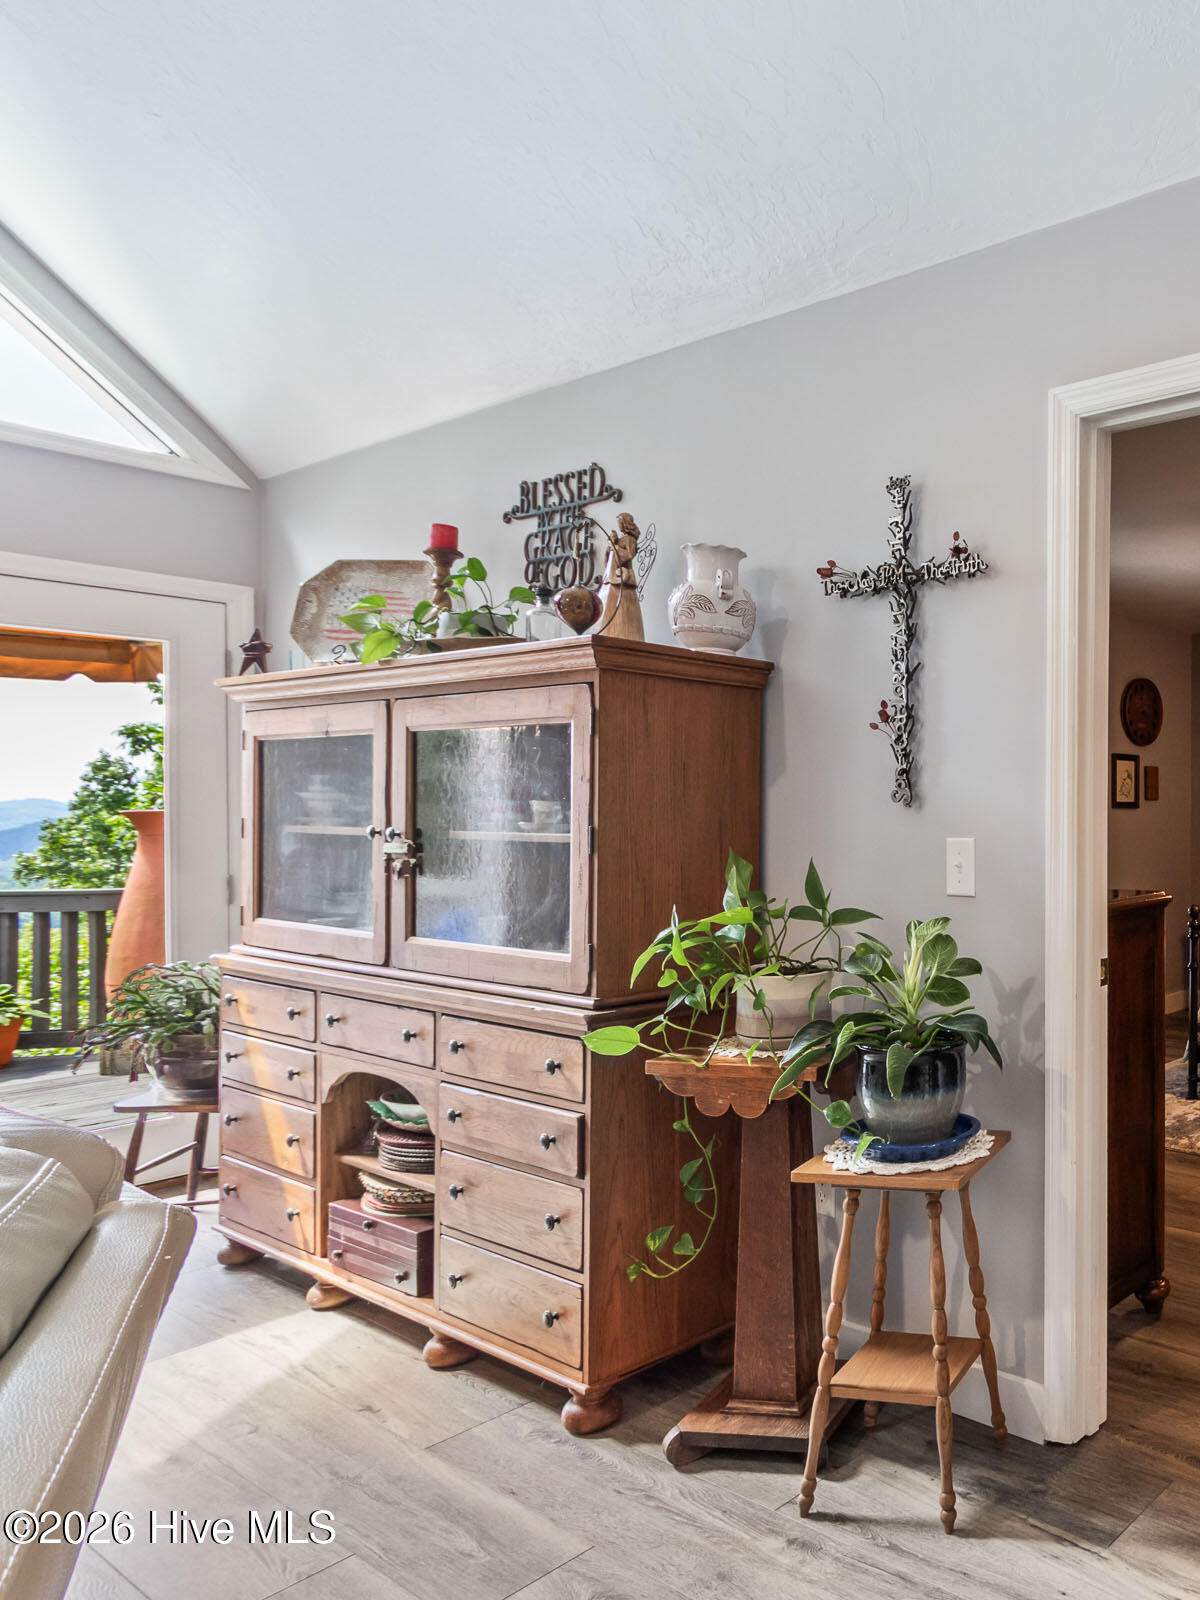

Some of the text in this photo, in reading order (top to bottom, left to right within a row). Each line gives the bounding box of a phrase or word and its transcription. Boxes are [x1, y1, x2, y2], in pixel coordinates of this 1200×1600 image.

[519, 462, 606, 514] BLESSED
[524, 520, 595, 561] GRACE
[544, 553, 596, 589] GOD
